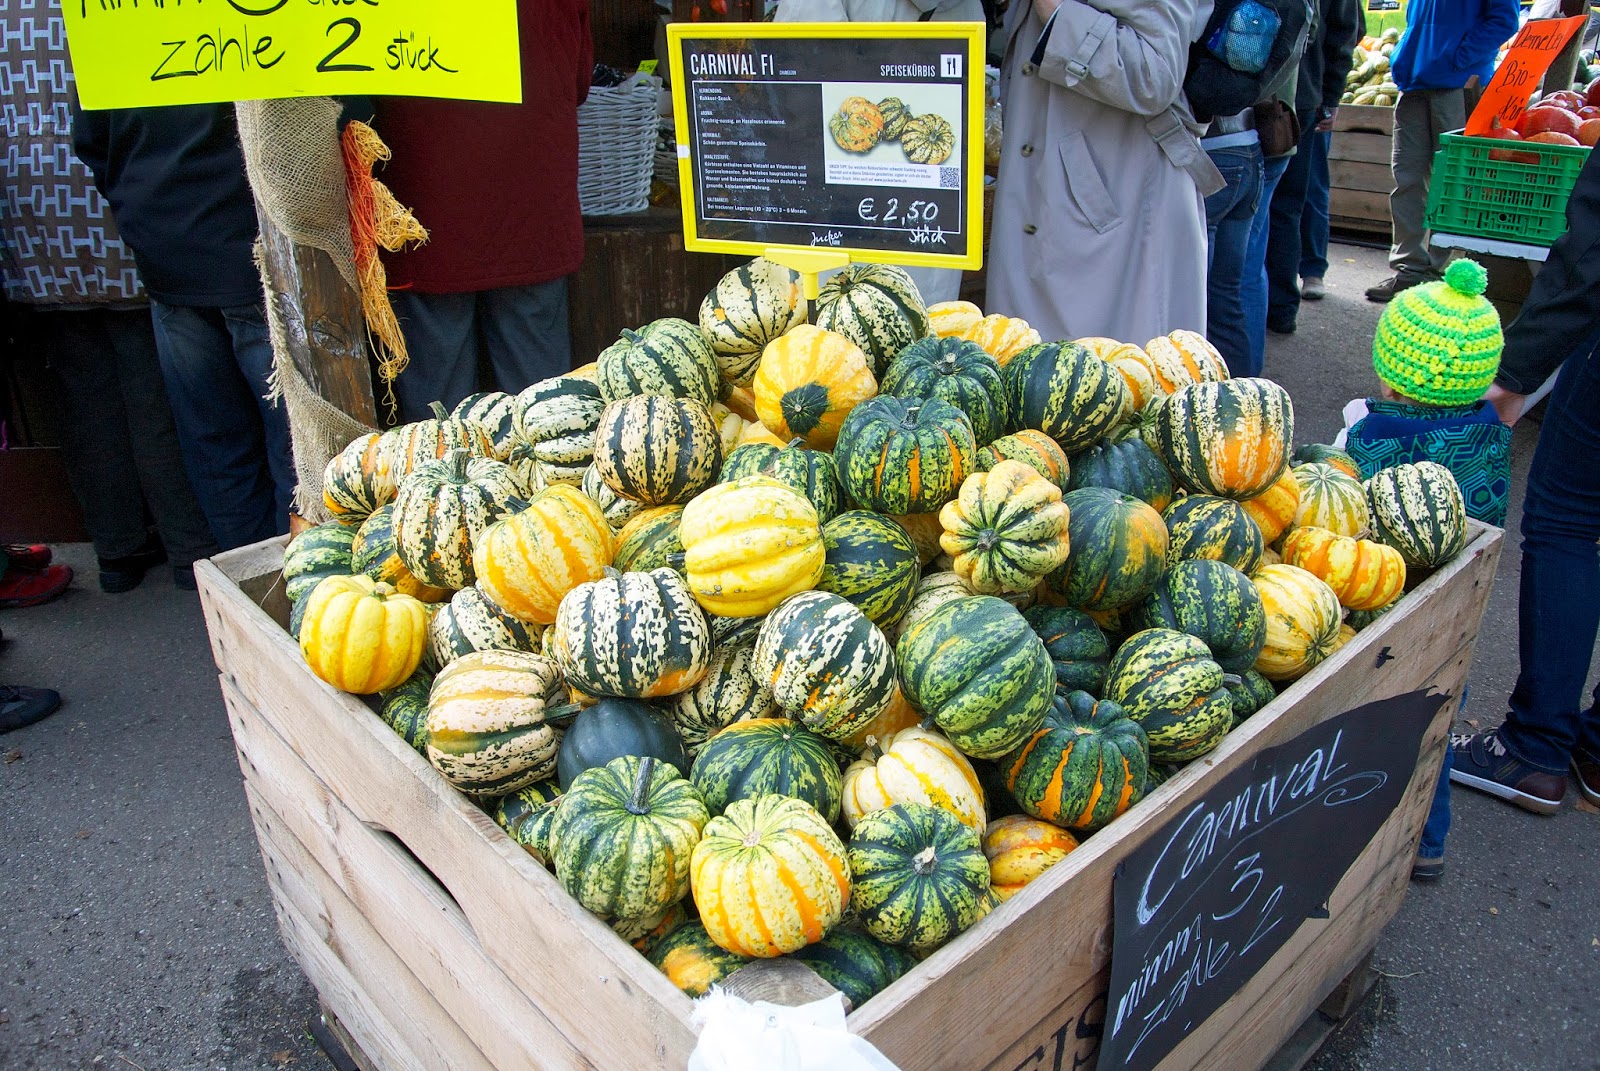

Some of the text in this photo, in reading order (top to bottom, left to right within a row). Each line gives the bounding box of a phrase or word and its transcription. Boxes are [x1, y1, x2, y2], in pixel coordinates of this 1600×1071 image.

[150, 16, 459, 81] zahle 2 stück
[690, 53, 756, 76] CARNIVAL
[880, 64, 936, 78] SPEISEKÜRBIS
[1212, 852, 1264, 921] 3
[1239, 885, 1284, 957] 2
